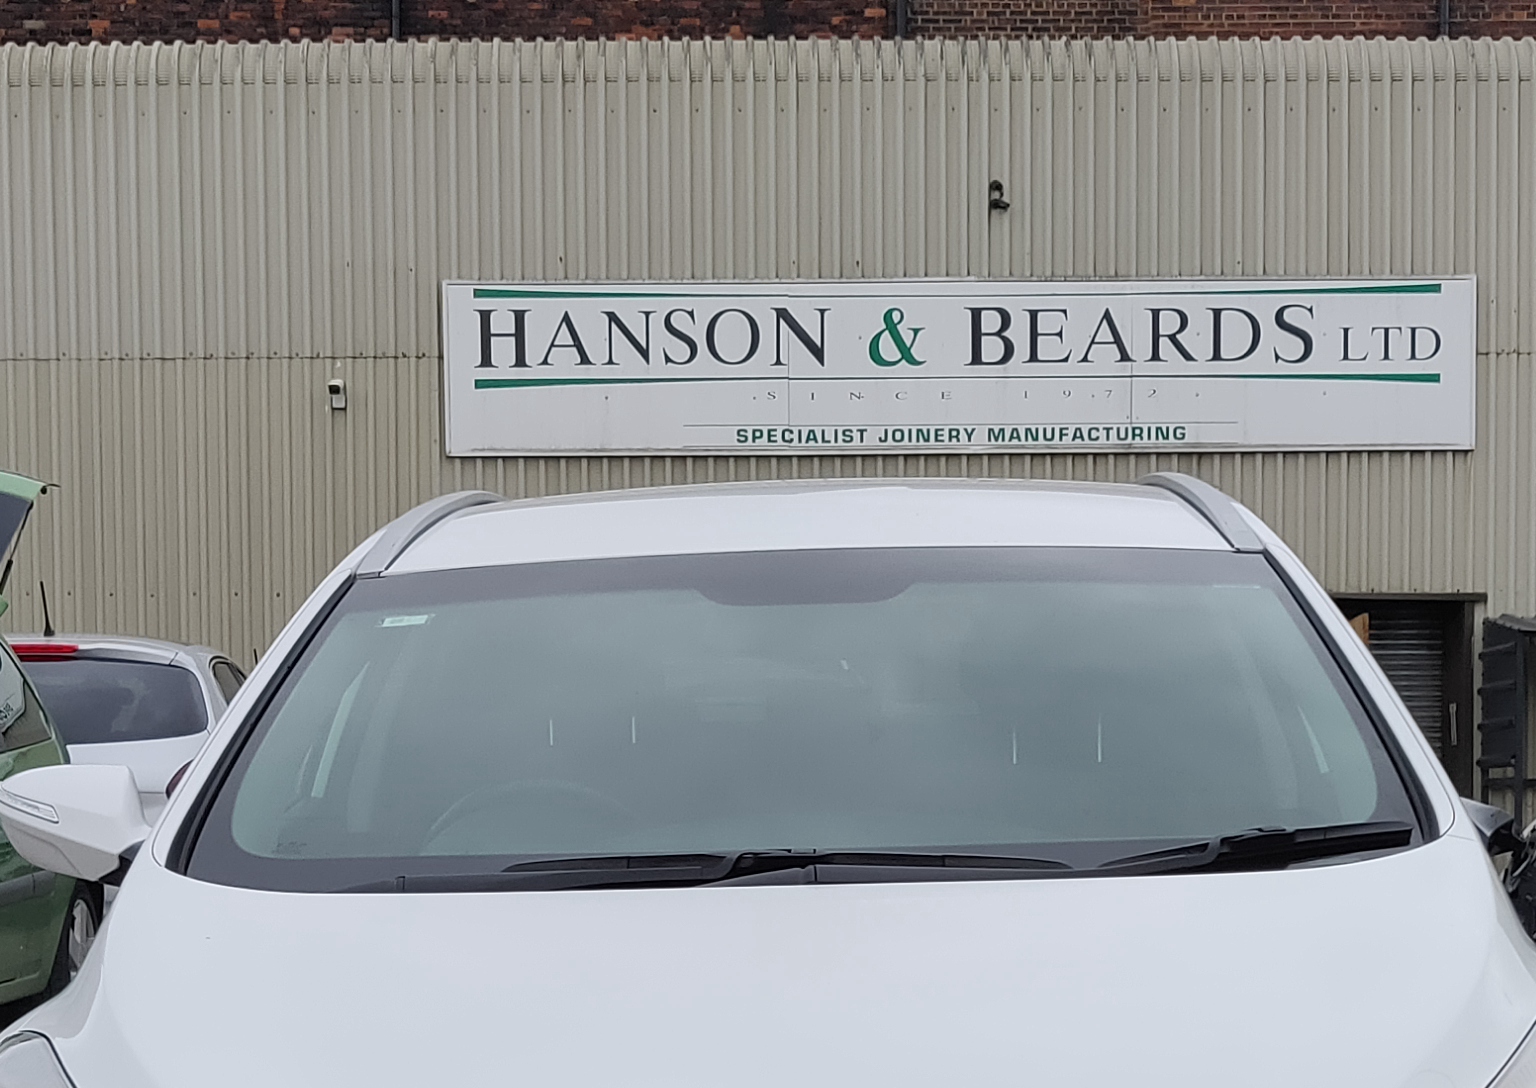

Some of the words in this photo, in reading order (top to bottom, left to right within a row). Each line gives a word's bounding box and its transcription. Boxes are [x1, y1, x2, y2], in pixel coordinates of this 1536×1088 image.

[474, 307, 831, 368] HANSON
[868, 307, 927, 367] &
[964, 304, 1314, 366] BEARDS
[1339, 326, 1442, 362] LTD
[766, 391, 952, 401] SINCE
[736, 428, 868, 444] SPECIALIST
[878, 427, 977, 444] JOINERY
[987, 425, 1187, 443] MANUFACTURING
